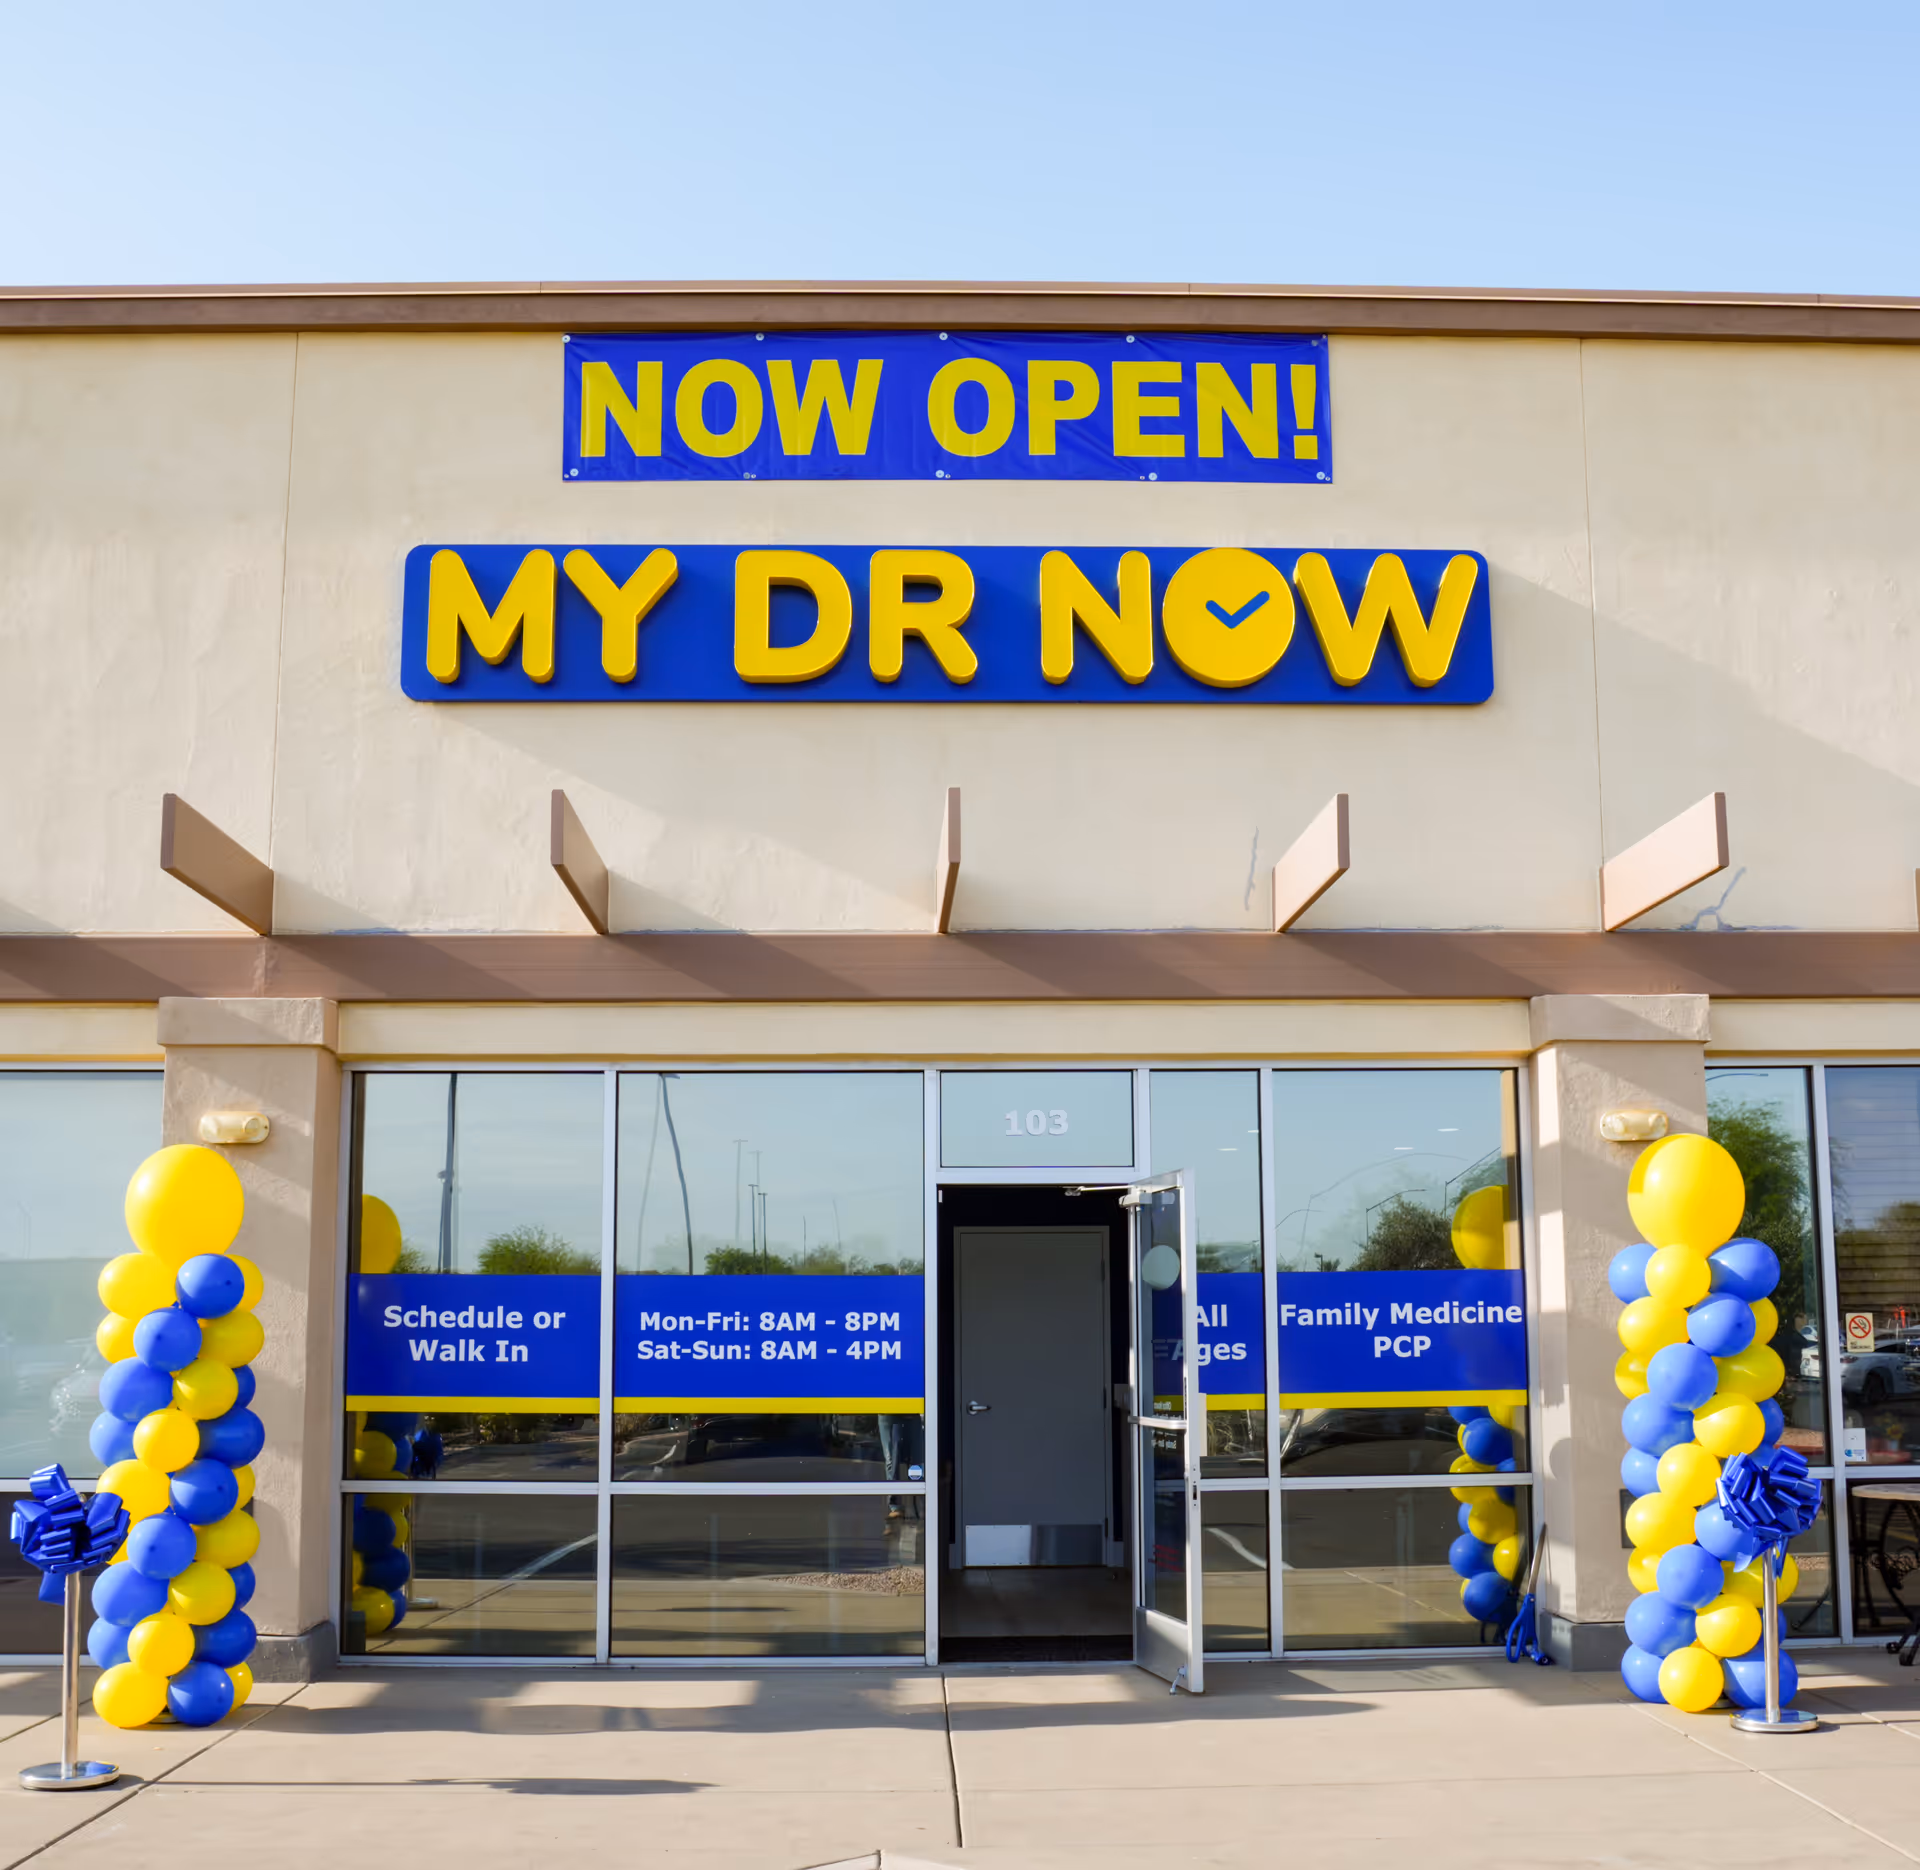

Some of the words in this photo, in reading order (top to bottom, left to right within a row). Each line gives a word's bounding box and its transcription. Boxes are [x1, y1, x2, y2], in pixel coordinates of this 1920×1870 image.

[580, 358, 884, 458] NOW
[927, 358, 1318, 460] OPEN!
[426, 547, 679, 684] MY
[733, 549, 979, 685] DR
[1039, 547, 1479, 688] NOW
[1005, 1109, 1069, 1136] 103
[383, 1305, 523, 1329] Schedule
[533, 1311, 566, 1329] or
[640, 1311, 749, 1331] Mon-Fri:
[759, 1311, 816, 1332] 8AM
[844, 1311, 900, 1332] 8PM
[1280, 1302, 1379, 1330] Family
[1390, 1301, 1523, 1325] Medicine
[408, 1339, 485, 1362] Walk
[495, 1340, 529, 1362] In
[637, 1340, 751, 1360] Sat-Sun:
[760, 1340, 817, 1360] 8AM
[846, 1340, 901, 1360] 4PM
[1374, 1335, 1432, 1358] PCP
